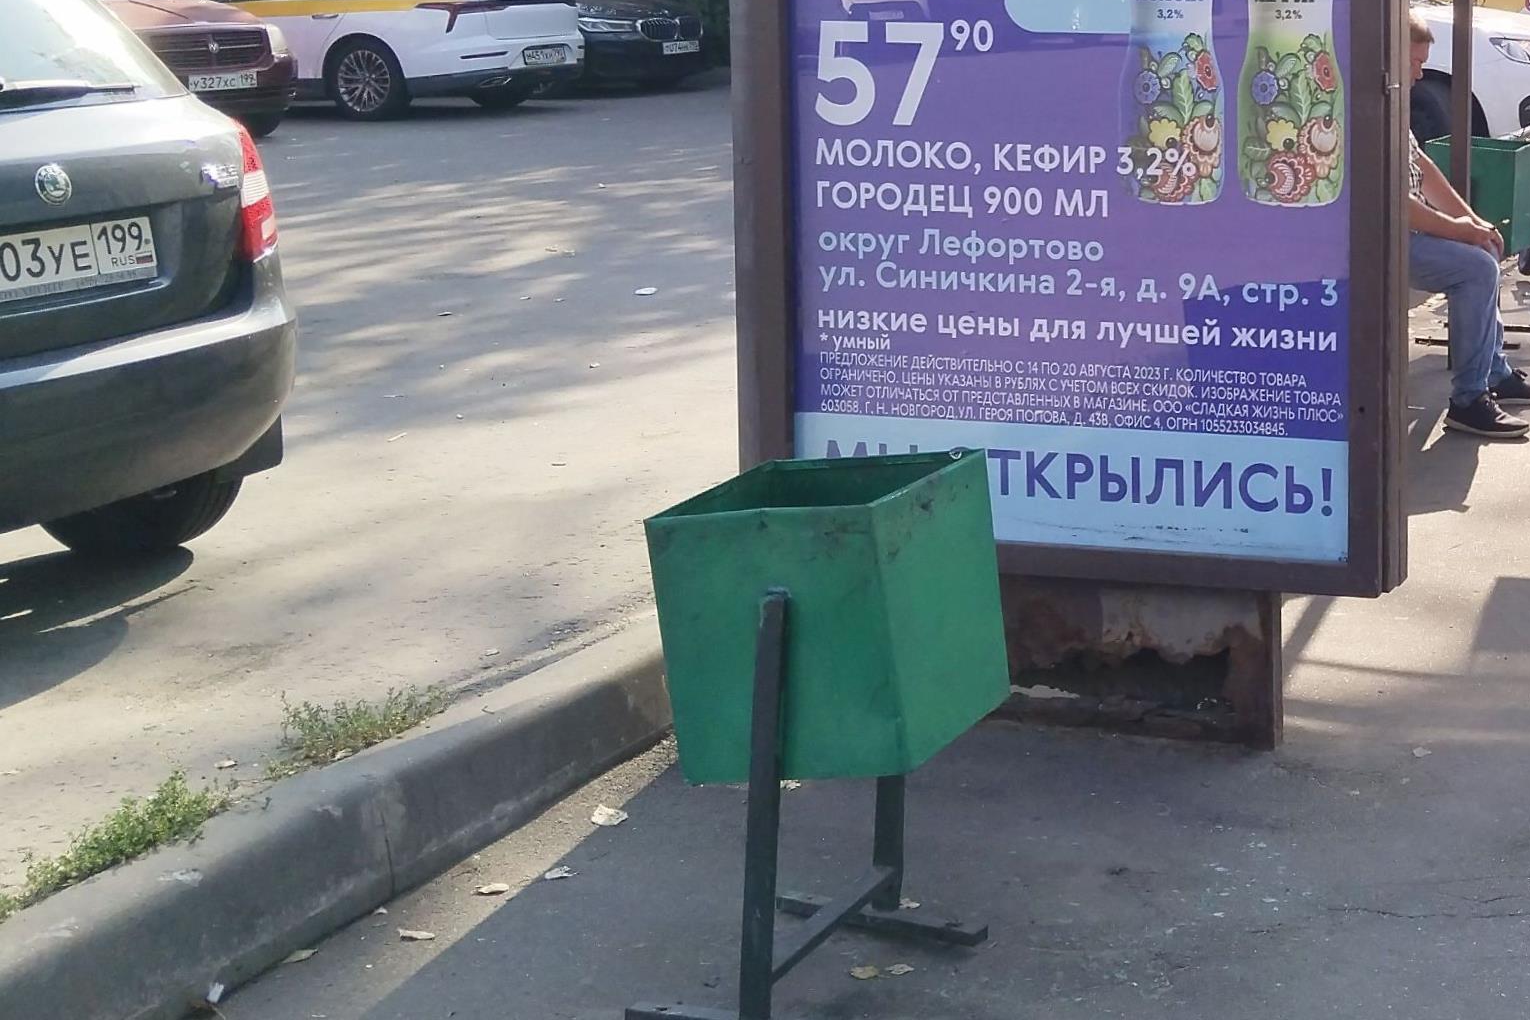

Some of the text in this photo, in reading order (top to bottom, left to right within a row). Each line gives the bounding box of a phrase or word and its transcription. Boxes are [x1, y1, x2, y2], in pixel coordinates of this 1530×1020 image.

[1157, 9, 1183, 19] 3,2%
[1275, 10, 1302, 20] 3,2%
[814, 21, 994, 127] 57 90
[816, 138, 1196, 180] МОЛОКО, КЕФИР 3,2%
[816, 182, 1108, 218] ГОРОДЕЦ 900 МЛ
[97, 222, 143, 255] 199
[819, 229, 1104, 264] округ Лефортово
[111, 253, 136, 266] RUS
[819, 262, 1338, 311] ул. Синичкина 2-я, д. 9А, стр. 3
[818, 310, 1337, 351] низкие цены для лучшей жизни
[834, 334, 890, 352] умный
[820, 352, 908, 369] ПРЕДЛОЖЕНИЕ
[911, 355, 1013, 373] ДЕЙСТВИТЕЛЬНО
[1015, 361, 1024, 373] С
[1027, 361, 1038, 373] 14
[1042, 362, 1060, 375] ПО
[1063, 363, 1077, 376] 20
[1080, 365, 1132, 379] АВГУСТА
[1134, 367, 1160, 380] 2023
[1176, 368, 1257, 385] КОЛИЧЕСТВО
[1259, 372, 1307, 387] ТОВАРА
[820, 368, 1341, 406] ОГРАНИЧЕНО. ЦЕНЫ УКАЗАНЫ В РУБЛЯХ С УЧЕТОМ ВСЕХ СКИДОК. ИЗОБРАЖЕНИЕ ТОВАРА
[820, 384, 1343, 423] МОЖЕТ ОТЛИЧАТЬСЯ ОТ ПРЕДСТАВЛЕННЫХ В МАГАЗИНЕ. ООО «СЛАДКАЯ ЖИЗНЬ ПЛЮС»
[979, 408, 1013, 422] ГЕРОЯ
[1016, 410, 1070, 425] ПОПОВА,
[1115, 414, 1151, 428] ОФИС
[1167, 417, 1197, 431] ОГРН
[1201, 419, 1288, 436] 1055233034845.
[948, 445, 1333, 516] ТКРЫЛИСЬ!
